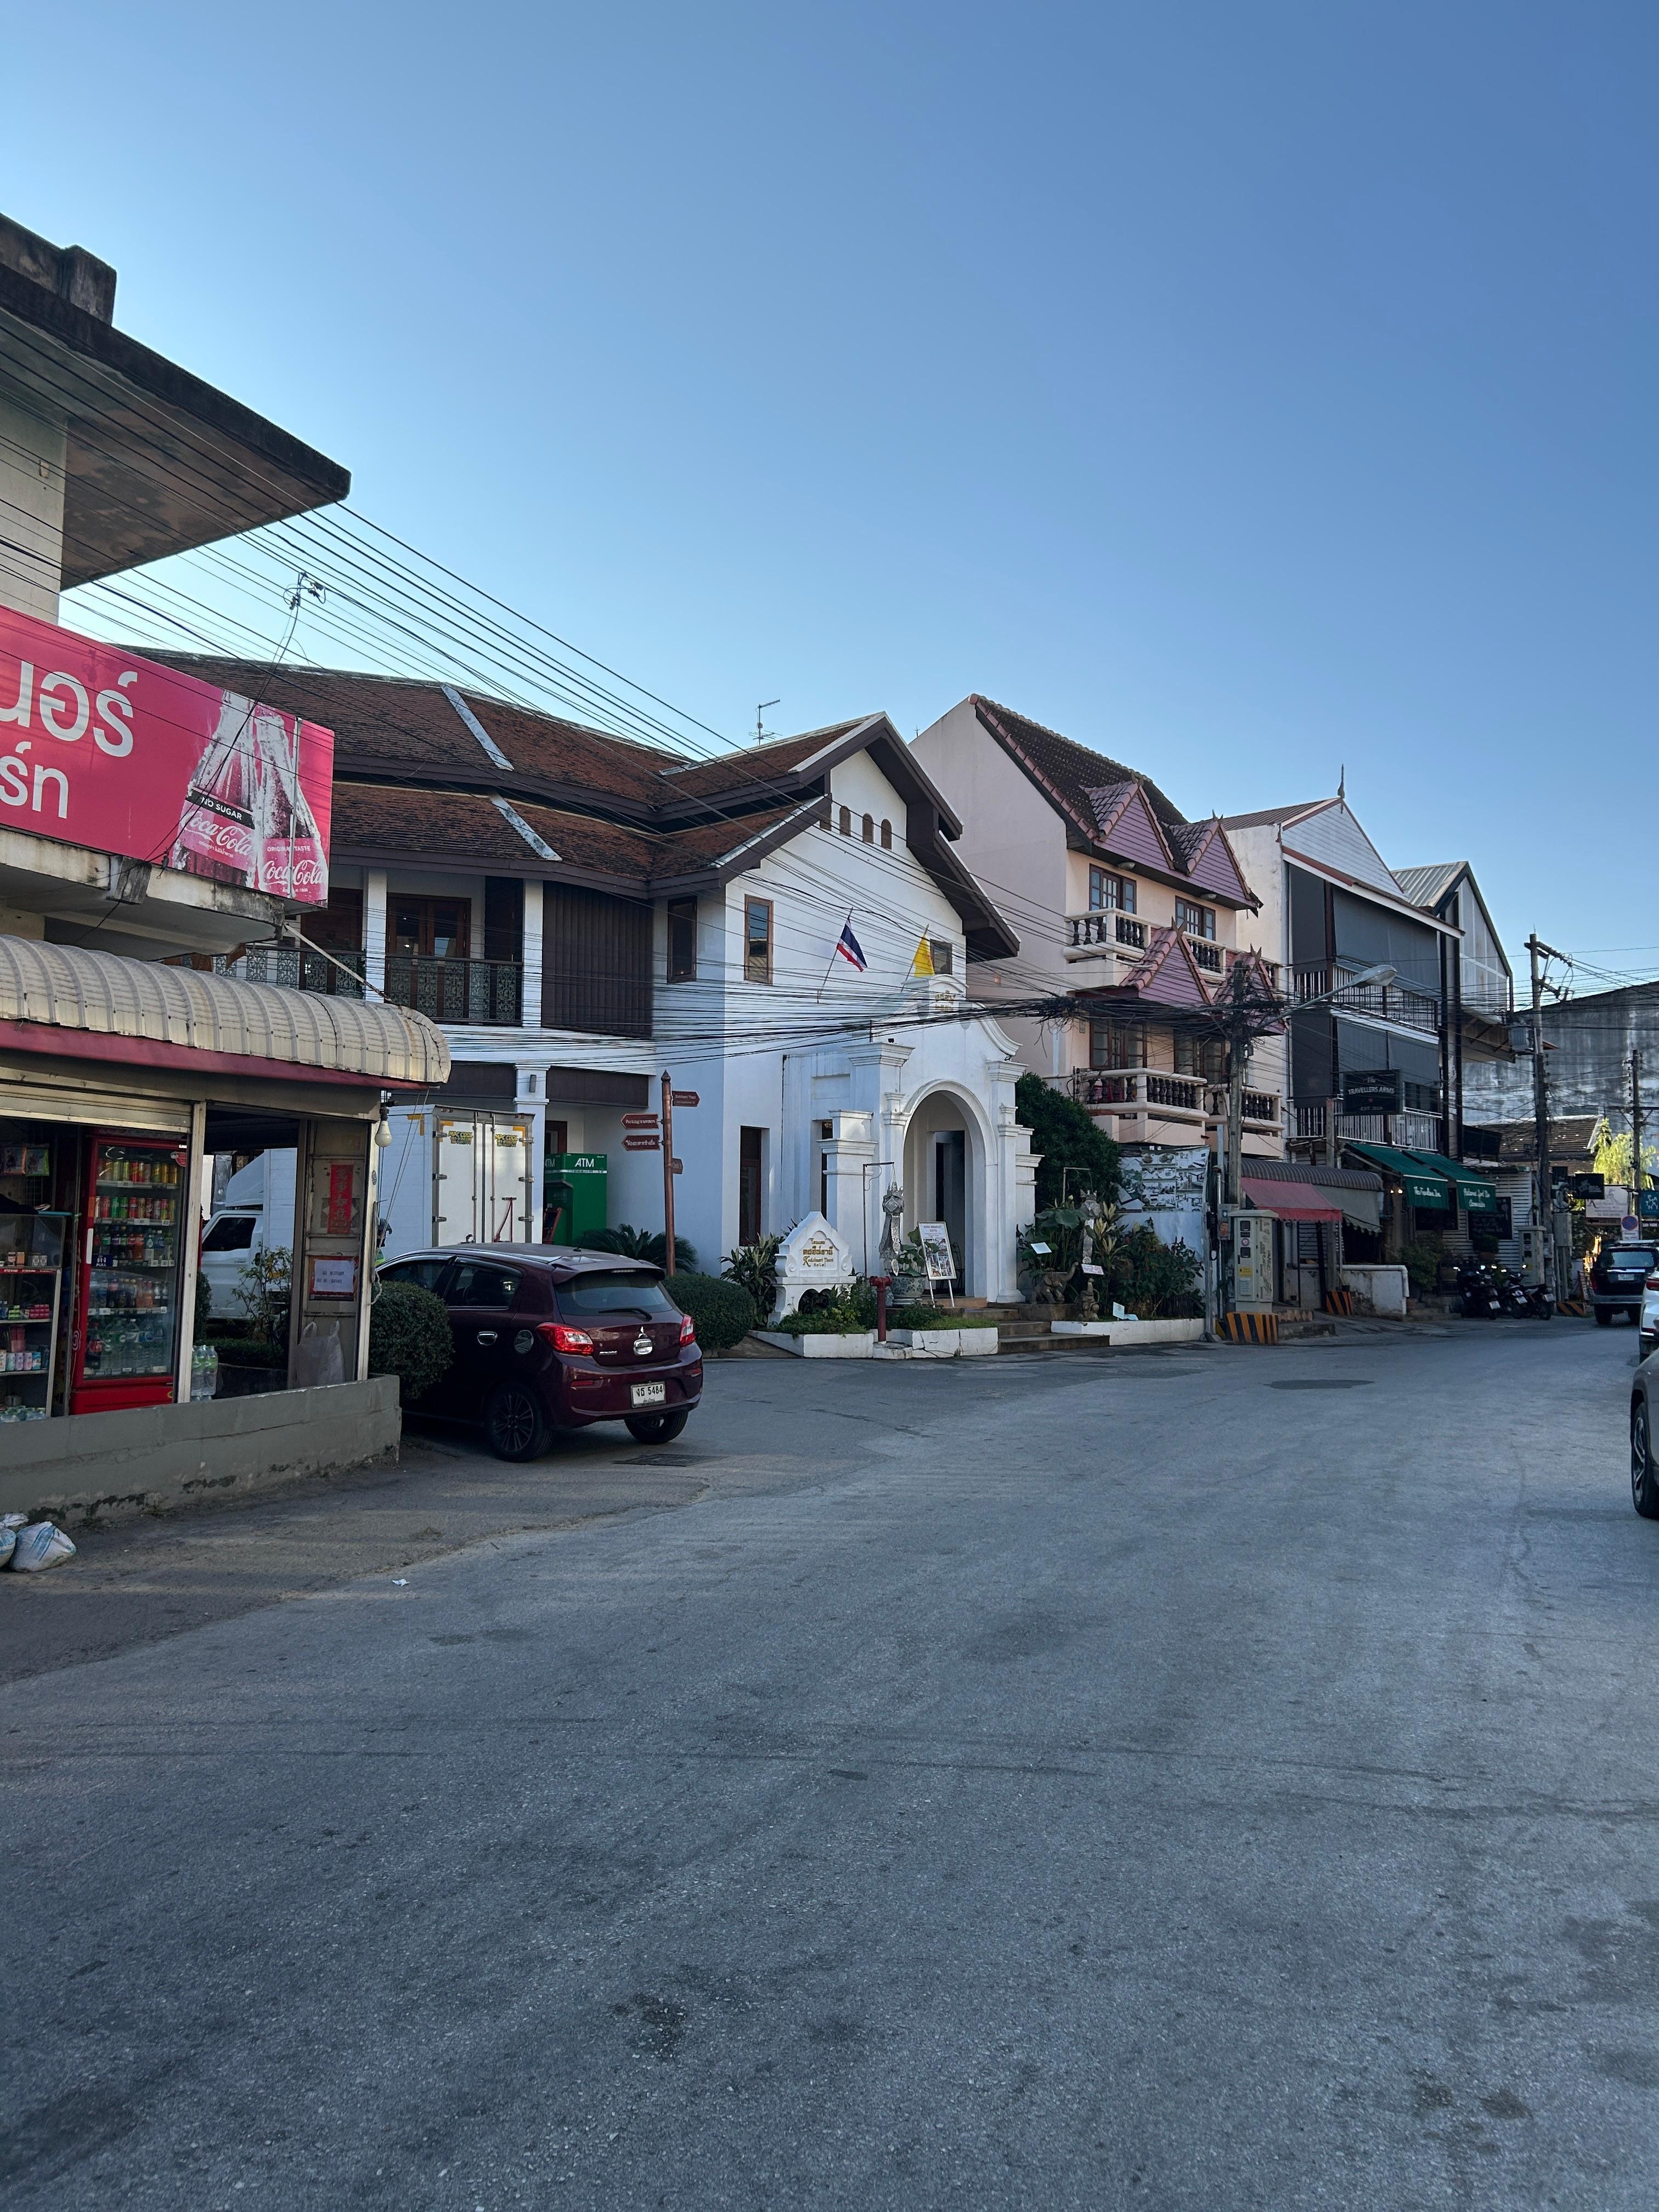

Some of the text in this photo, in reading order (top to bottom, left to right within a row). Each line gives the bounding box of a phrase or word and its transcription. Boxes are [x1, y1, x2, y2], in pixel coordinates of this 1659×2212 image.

[215, 803, 243, 820] SUGAR
[180, 810, 253, 856] Coca-Cola
[1348, 1086, 1378, 1095] TRAVELLERS
[544, 1158, 555, 1167] ATM
[575, 1158, 594, 1167] ATM
[648, 1385, 663, 1395] 5484
